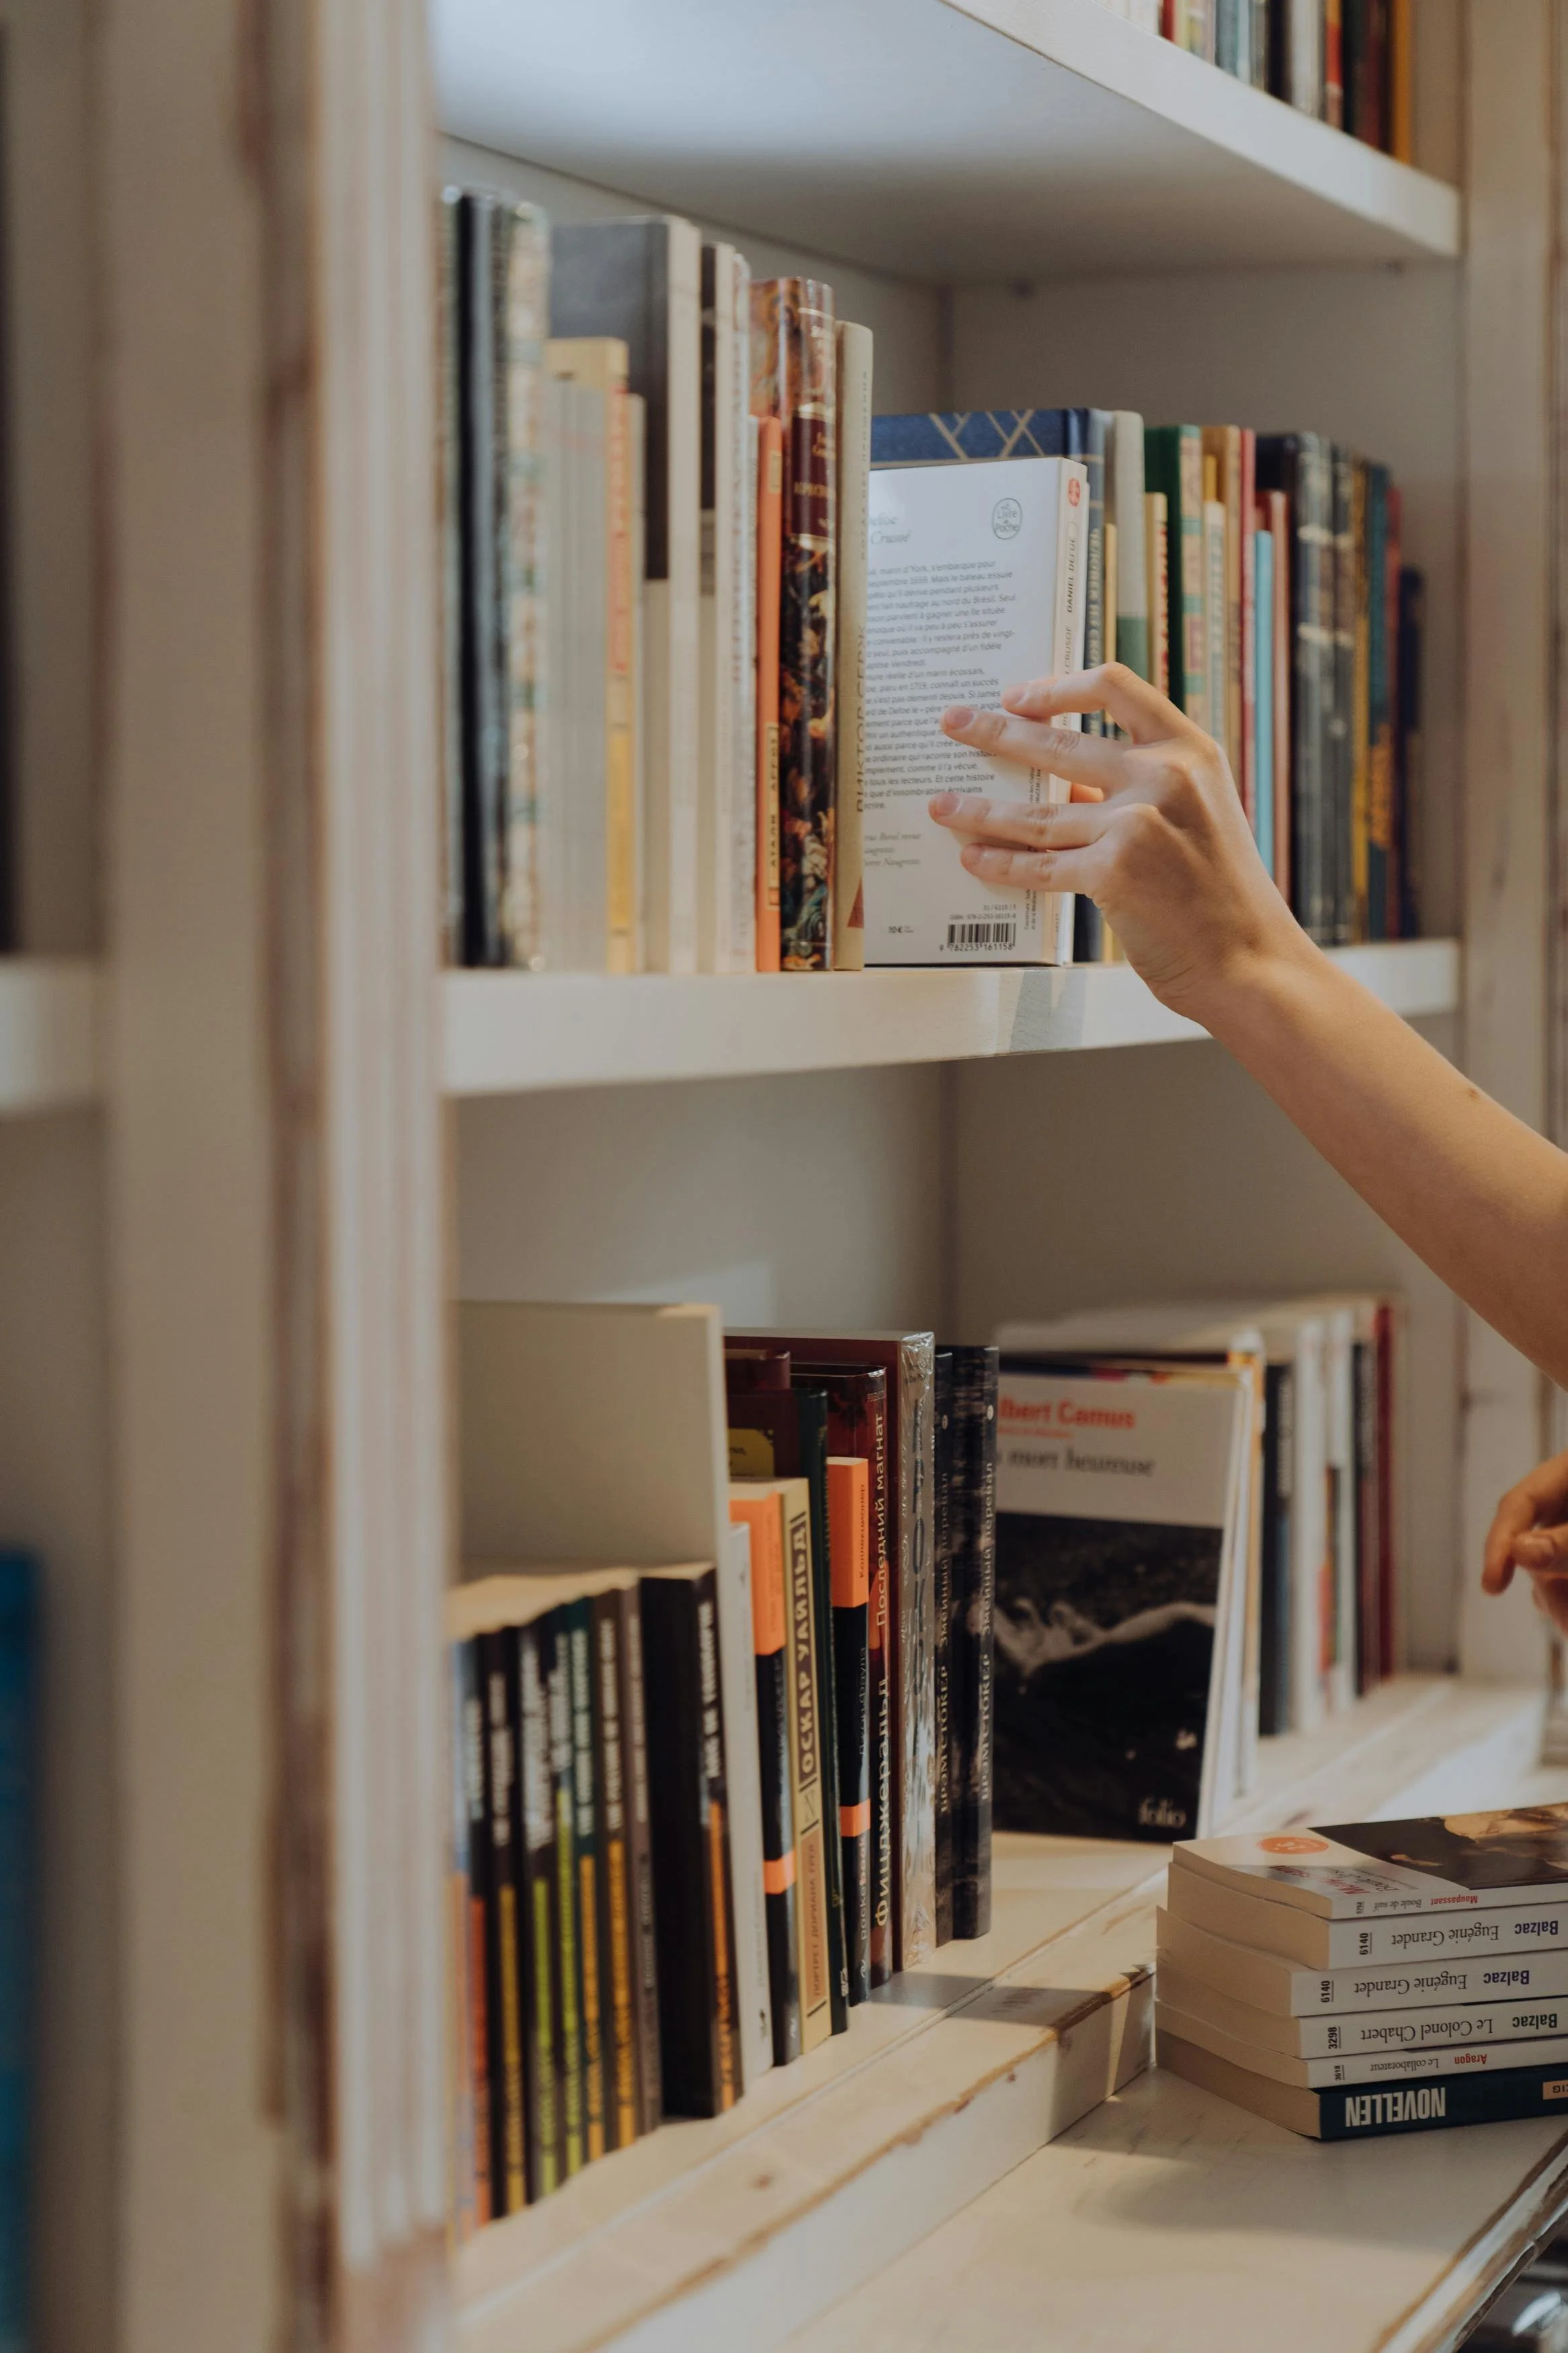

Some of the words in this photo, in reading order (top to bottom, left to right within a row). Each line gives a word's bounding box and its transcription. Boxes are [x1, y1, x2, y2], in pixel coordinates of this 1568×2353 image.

[950, 943, 979, 952] 782253
[984, 943, 1013, 951] 161158
[998, 1398, 1052, 1423] lbert
[1057, 1399, 1137, 1429] Camus
[874, 1412, 885, 1490] магнат
[939, 1472, 949, 1552] перевал
[983, 1462, 993, 1541] перевал
[874, 1497, 887, 1627] Последний
[792, 1526, 810, 1661] УАЙЛЬД
[939, 1558, 949, 1647] Змеиный
[983, 1548, 993, 1636] Змеиный
[940, 1665, 949, 1748] СТОКЕР
[982, 1653, 991, 1738] СТОКЕР
[797, 1670, 815, 1773] ОСКАР
[875, 1677, 891, 1927] Фицджеральд
[1139, 1796, 1186, 1828] folio
[859, 1835, 867, 1940] pocketbook
[1372, 1902, 1389, 1912] suif
[1389, 1901, 1399, 1909] de
[1400, 1899, 1423, 1909] Boule
[1430, 1894, 1479, 1907] Maupassant
[1391, 1931, 1445, 1949] Grandet
[1448, 1922, 1499, 1944] Eugénie
[1514, 1921, 1559, 1937] Balzac
[1358, 1933, 1369, 1956] 6140
[1354, 1979, 1410, 1997] Grandet
[1413, 1971, 1468, 1992] Eugénie
[1483, 1970, 1530, 1986] Balzac
[1320, 1980, 1331, 2003] 6140
[1419, 2020, 1473, 2040] Colonel
[1476, 2018, 1493, 2034] Le
[1512, 2013, 1559, 2030] Balzac
[1327, 2026, 1338, 2049] 3298
[1360, 2026, 1416, 2044] Chabert
[1369, 2059, 1427, 2073] collaborateur
[1428, 2058, 1439, 2069] Le
[1454, 2052, 1488, 2067] Aragon
[1553, 2083, 1568, 2093] IG
[1345, 2086, 1446, 2127] NOVELLEN
